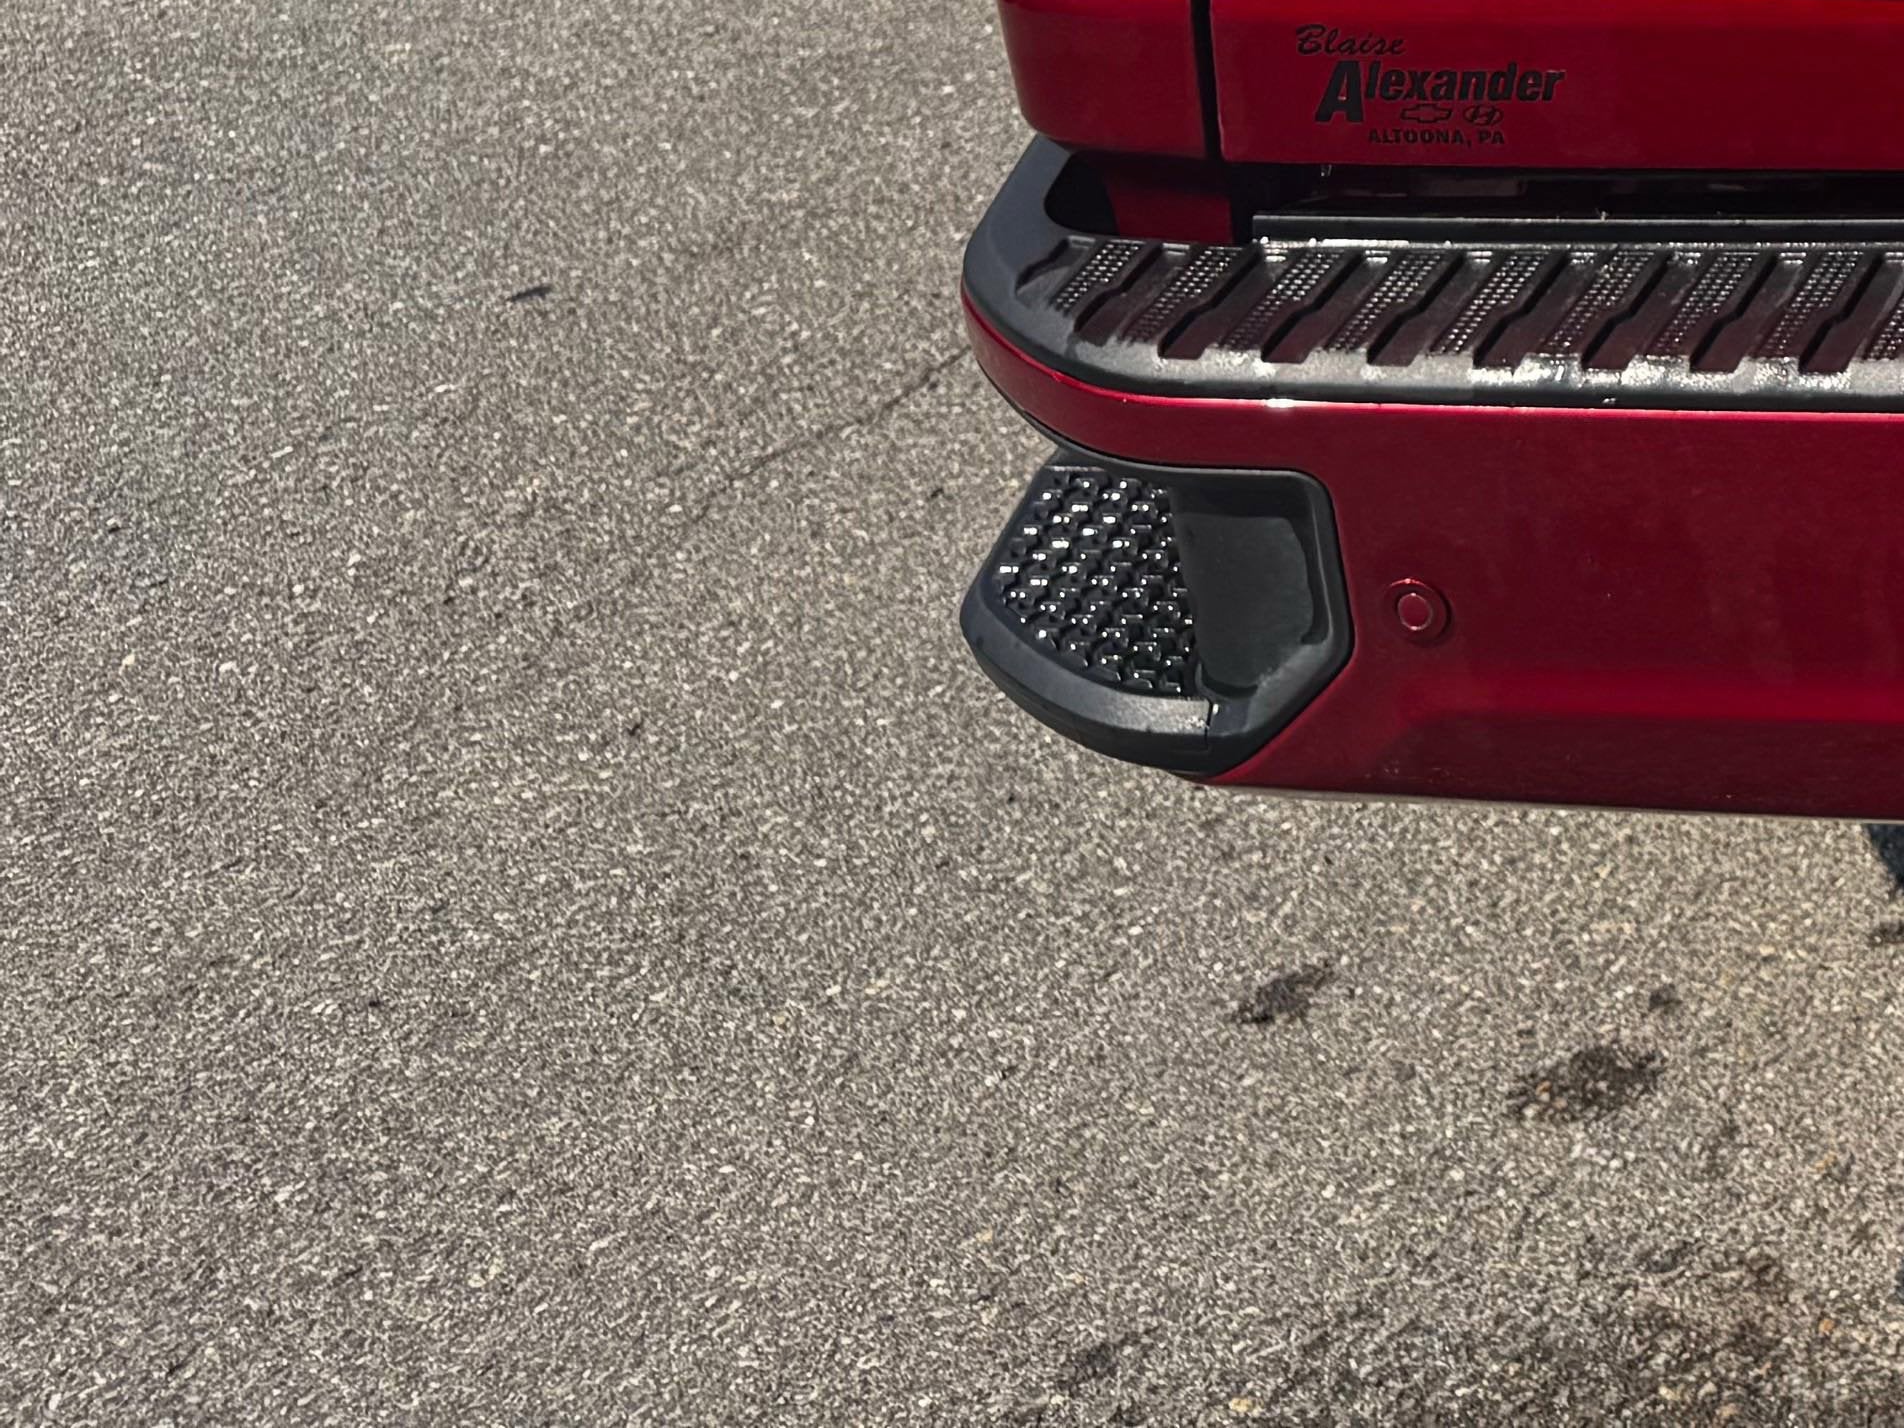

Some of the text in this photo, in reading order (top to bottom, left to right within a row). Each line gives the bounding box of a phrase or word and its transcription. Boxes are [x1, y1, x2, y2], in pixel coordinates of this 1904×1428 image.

[1295, 23, 1407, 55] Blaise
[1314, 60, 1567, 123] Alexander
[1369, 128, 1505, 148] ALTOONA, PA
